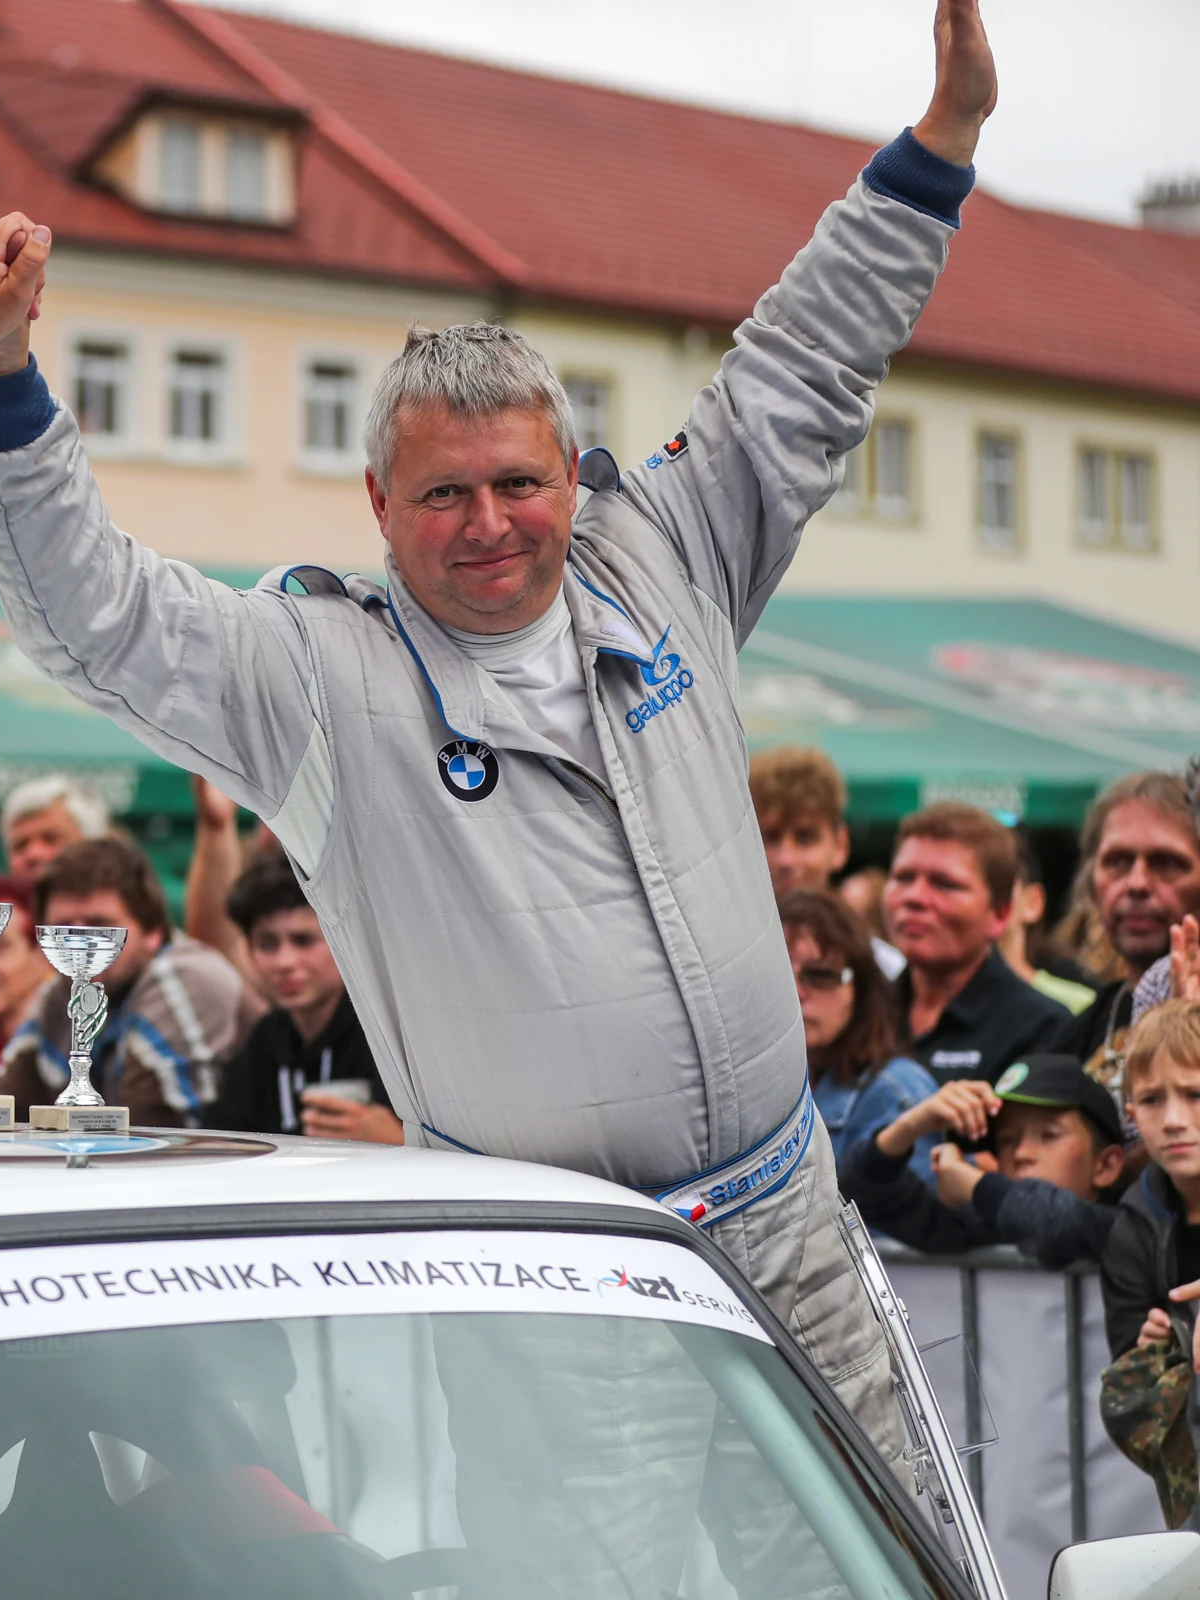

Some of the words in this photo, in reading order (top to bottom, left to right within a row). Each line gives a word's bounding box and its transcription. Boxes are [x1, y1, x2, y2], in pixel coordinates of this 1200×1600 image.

[625, 668, 694, 734] galuppo
[438, 741, 490, 764] BMW
[709, 1127, 800, 1206] Stanislav
[312, 1260, 591, 1293] KLIMATIZACE
[682, 1289, 755, 1325] SERVIS
